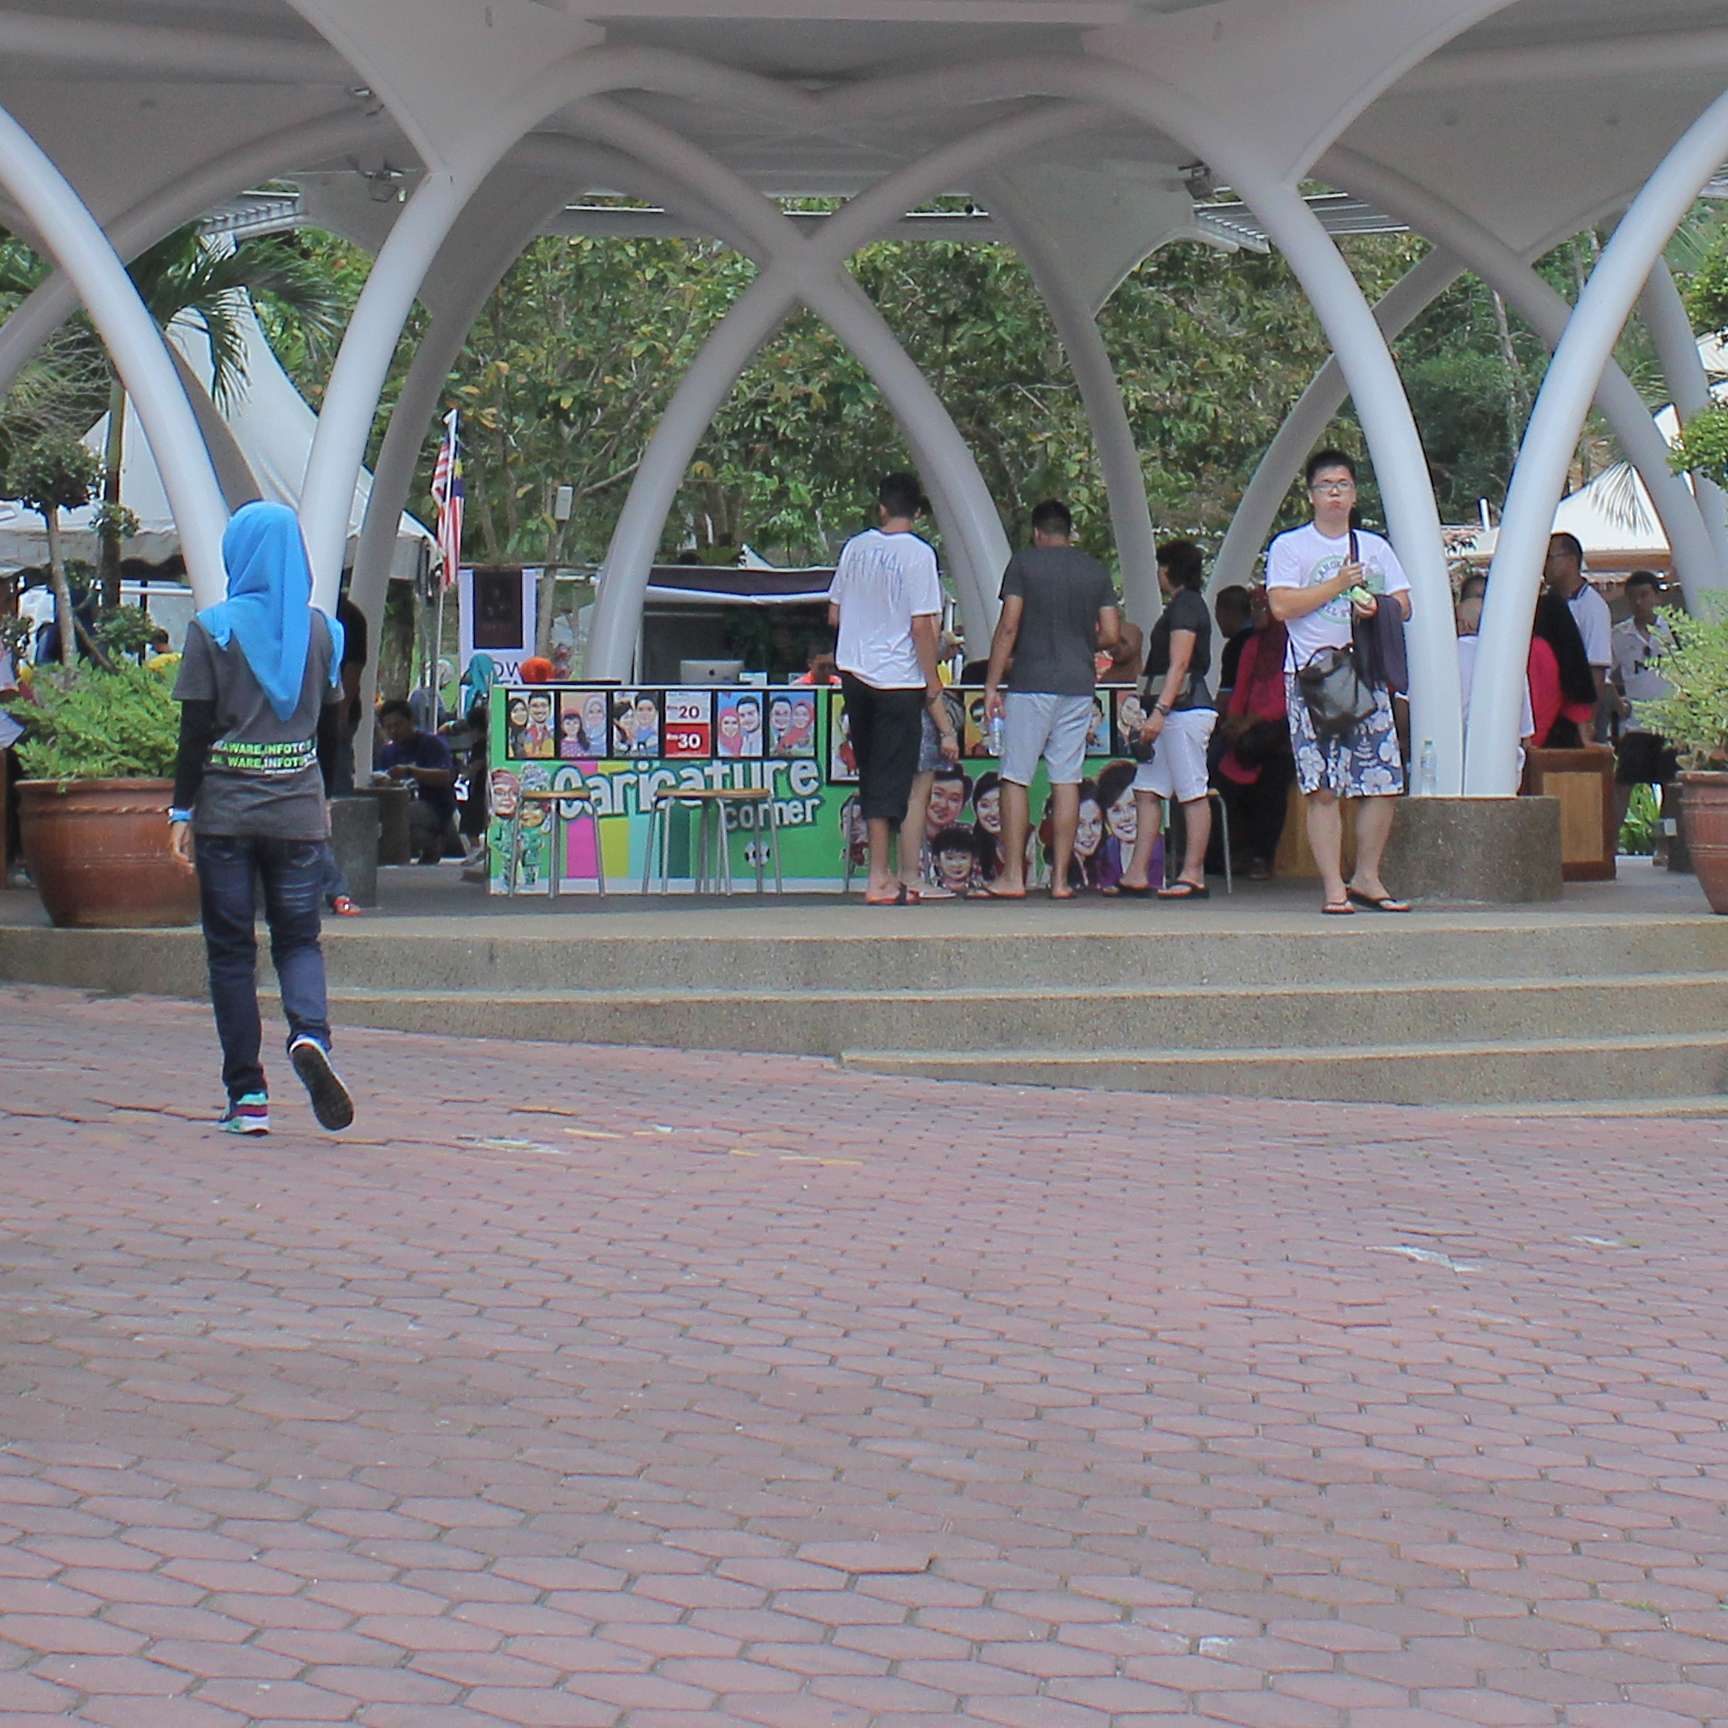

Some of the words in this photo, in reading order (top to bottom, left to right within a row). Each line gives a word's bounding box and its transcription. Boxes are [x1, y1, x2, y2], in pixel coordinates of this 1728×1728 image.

[679, 705, 700, 719] 20
[678, 734, 701, 749] 30
[553, 760, 820, 819] Caricature
[724, 798, 820, 828] corner
